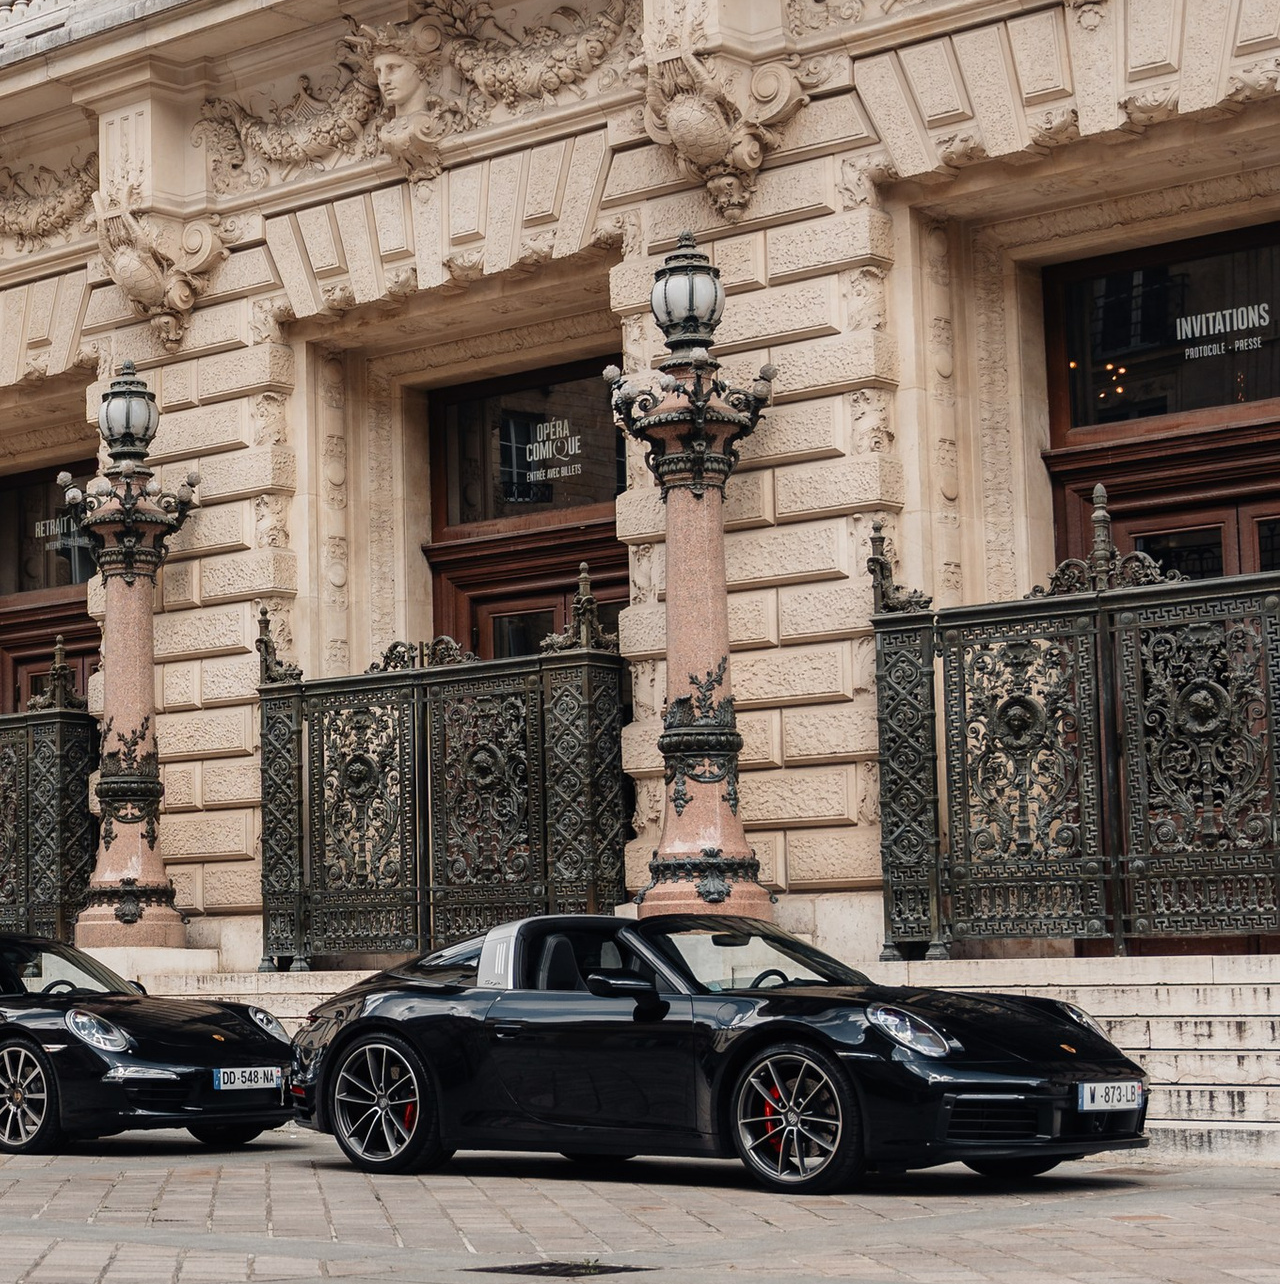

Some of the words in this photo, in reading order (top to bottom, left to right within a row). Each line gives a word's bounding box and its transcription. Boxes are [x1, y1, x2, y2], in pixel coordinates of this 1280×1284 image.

[1176, 303, 1270, 340] INVITATIONS
[1185, 342, 1225, 360] PROTOCOLE
[1234, 336, 1262, 352] PRESSE
[536, 417, 570, 441] OPÉRA
[526, 435, 581, 462] COMIQUE
[526, 468, 546, 482] ENTRÉE
[547, 467, 560, 479] AVEC
[561, 463, 582, 477] BILLETS
[35, 517, 67, 538] RETRAIT
[222, 1069, 275, 1085] DD-548-NA
